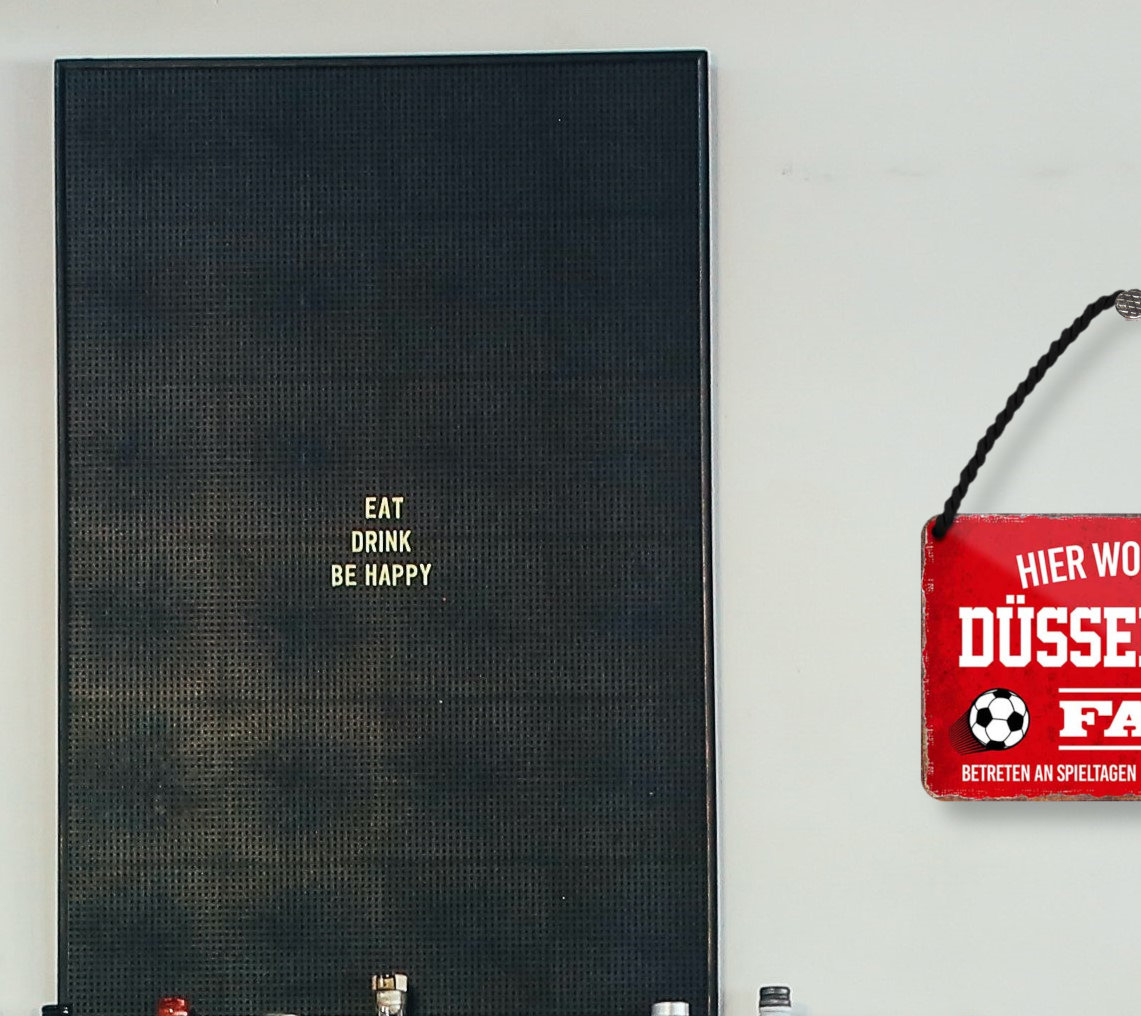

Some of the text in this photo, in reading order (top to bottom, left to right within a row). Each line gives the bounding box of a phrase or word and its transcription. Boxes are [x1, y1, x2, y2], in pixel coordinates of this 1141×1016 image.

[365, 496, 404, 519] EAT
[351, 529, 412, 553] DRINK
[331, 563, 432, 587] BE HAPPY
[1016, 544, 1087, 589] HIER
[962, 764, 1030, 782] BETRETEN
[1034, 764, 1054, 782] AN
[1056, 764, 1137, 782] SPIELTAGEN
